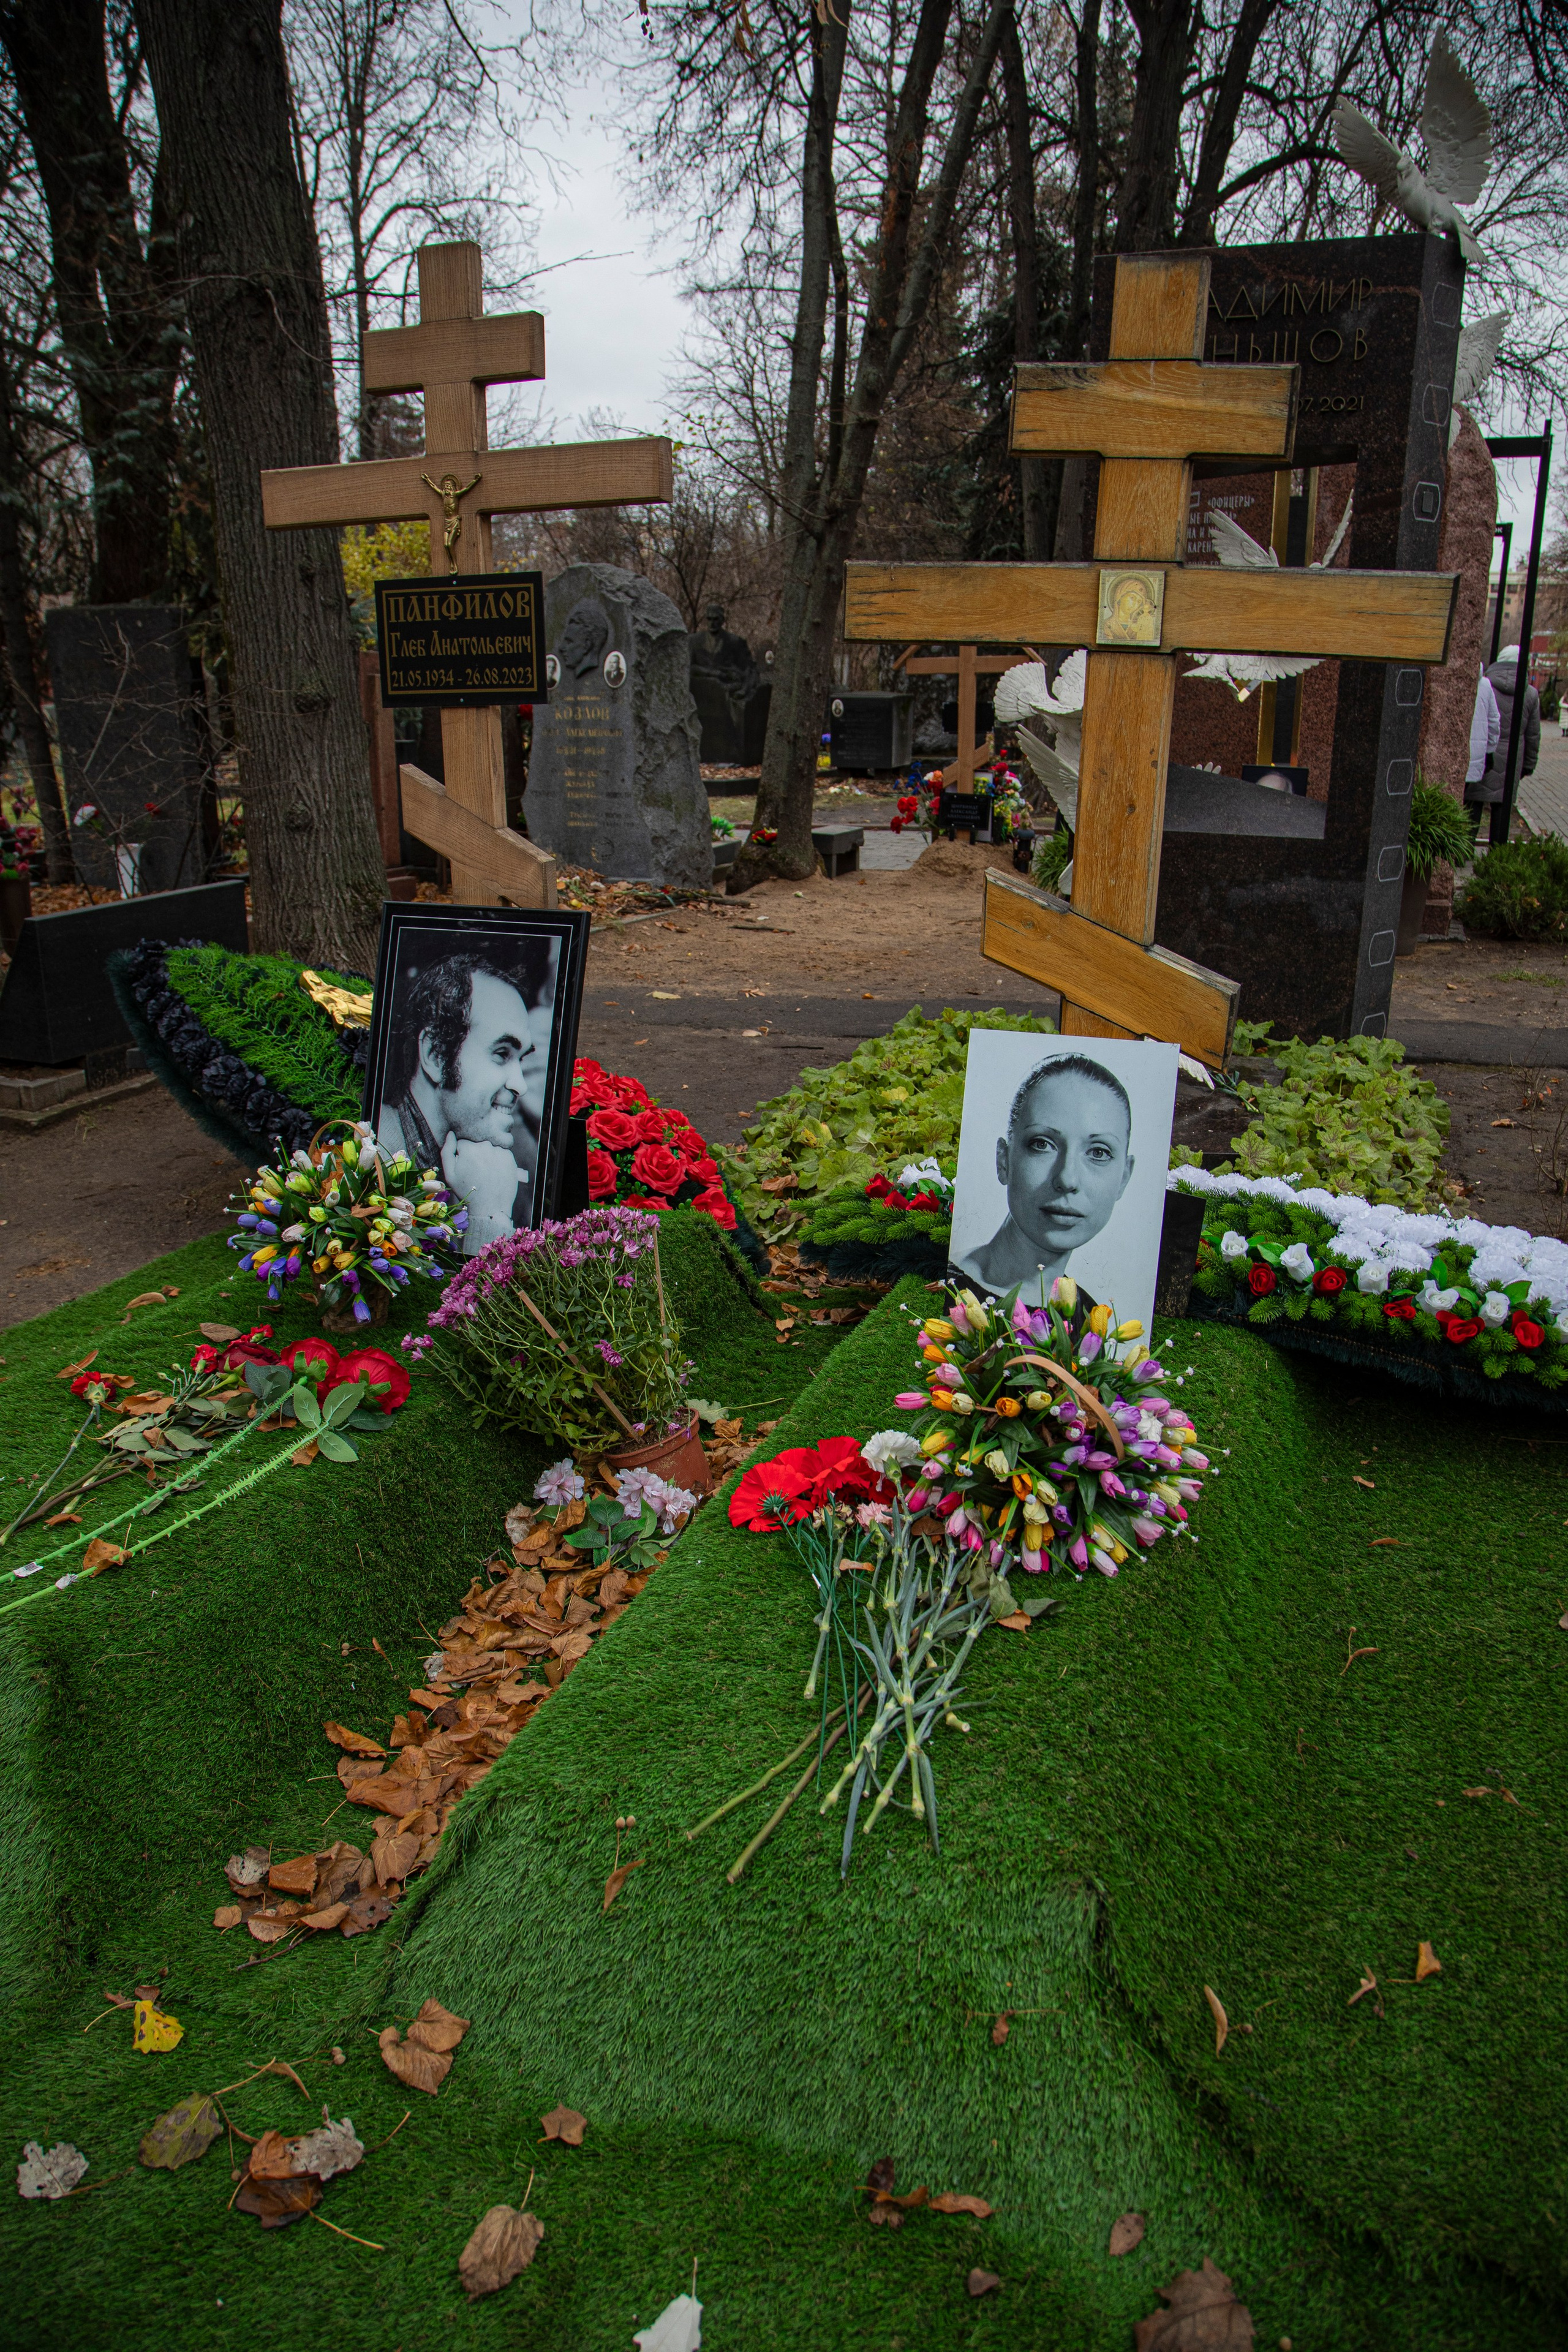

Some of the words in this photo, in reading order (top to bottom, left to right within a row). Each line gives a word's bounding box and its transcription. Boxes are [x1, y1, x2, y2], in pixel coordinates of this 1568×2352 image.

[388, 590, 530, 623] ПАНФИЛОВ
[391, 669, 454, 687] 21.05.1934
[466, 666, 533, 685] 26.08.2023
